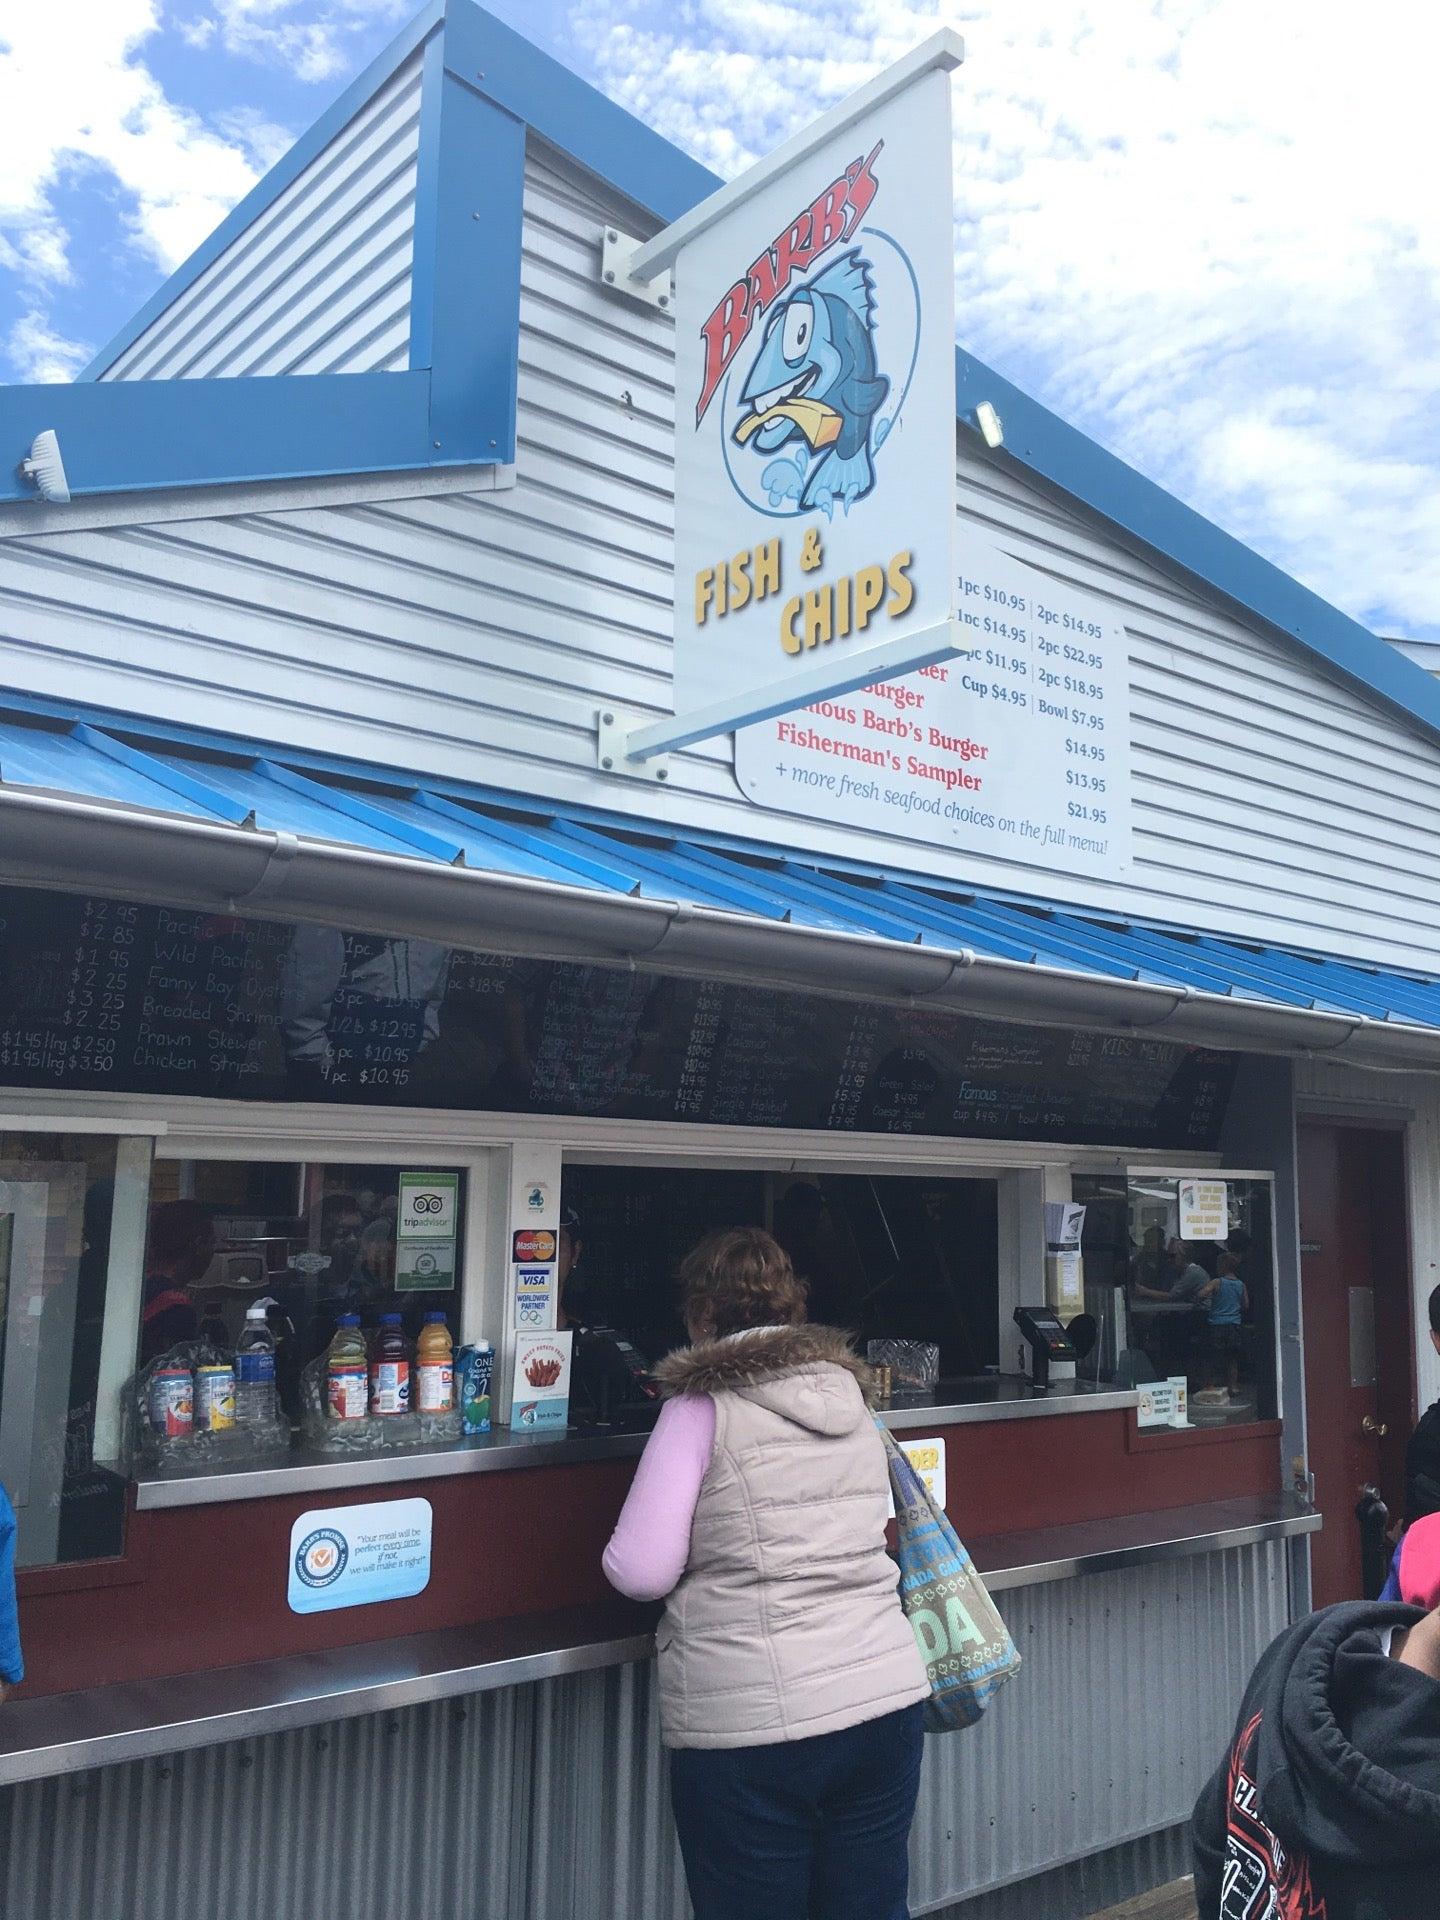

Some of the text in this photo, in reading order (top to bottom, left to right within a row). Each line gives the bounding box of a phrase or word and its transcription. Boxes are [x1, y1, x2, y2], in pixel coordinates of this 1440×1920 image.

[695, 527, 823, 627] FISH &
[780, 550, 916, 656] CHIPS
[958, 576, 1102, 639] 1pc $10.95 2pc $14.95
[984, 617, 1026, 643] $14.95
[1038, 636, 1060, 655] 2pc
[1064, 645, 1103, 670] $22.95
[986, 649, 1027, 675] $11.95
[1038, 668, 1060, 687] 2pc
[1064, 675, 1104, 700] $18.95
[962, 675, 988, 698] Cup
[992, 684, 1027, 707] $4.95
[1039, 699, 1068, 720] Bowl
[1072, 709, 1104, 731] $7.95
[863, 708, 923, 743] Barb's
[929, 727, 989, 762] Burger
[1066, 770, 1106, 792] $13.95
[1066, 738, 1105, 762] $14.95
[776, 721, 1107, 824] Fisherman's Sampler $21.95
[792, 766, 836, 790] more
[836, 775, 880, 801] fresh
[884, 788, 941, 813] seafood
[944, 801, 995, 828] choices
[998, 818, 1016, 833] on
[1020, 820, 1041, 839] the
[1041, 825, 1065, 846] full
[1068, 833, 1108, 855] menu!
[158, 909, 214, 938] Pacific
[154, 940, 197, 963] Wild
[212, 946, 264, 970] Pacific
[147, 965, 197, 1000] Fanny
[205, 972, 234, 1001] Bay
[142, 995, 211, 1020] Breaded
[226, 1002, 283, 1030] Shrimp
[137, 1022, 191, 1046] Prawn
[207, 1029, 267, 1050] Skewer
[364, 1043, 410, 1063] $10.95
[1100, 1037, 1134, 1057] KIDS
[133, 1046, 196, 1069] Chicken
[209, 1054, 260, 1079] Strips
[359, 1066, 411, 1086] $10.95
[959, 1081, 997, 1101] Famous
[404, 1218, 447, 1228] tripadvisor
[517, 1240, 554, 1251] MasterCard
[523, 1276, 546, 1285] VISA
[517, 1294, 550, 1302] WORLDWIDE
[521, 1302, 546, 1310] PARTNER
[475, 1358, 493, 1367] ONE
[379, 1531, 397, 1540] meal
[412, 1528, 421, 1536] be
[355, 1544, 381, 1557] perfect
[350, 1567, 361, 1575] we
[377, 1561, 397, 1570] make
